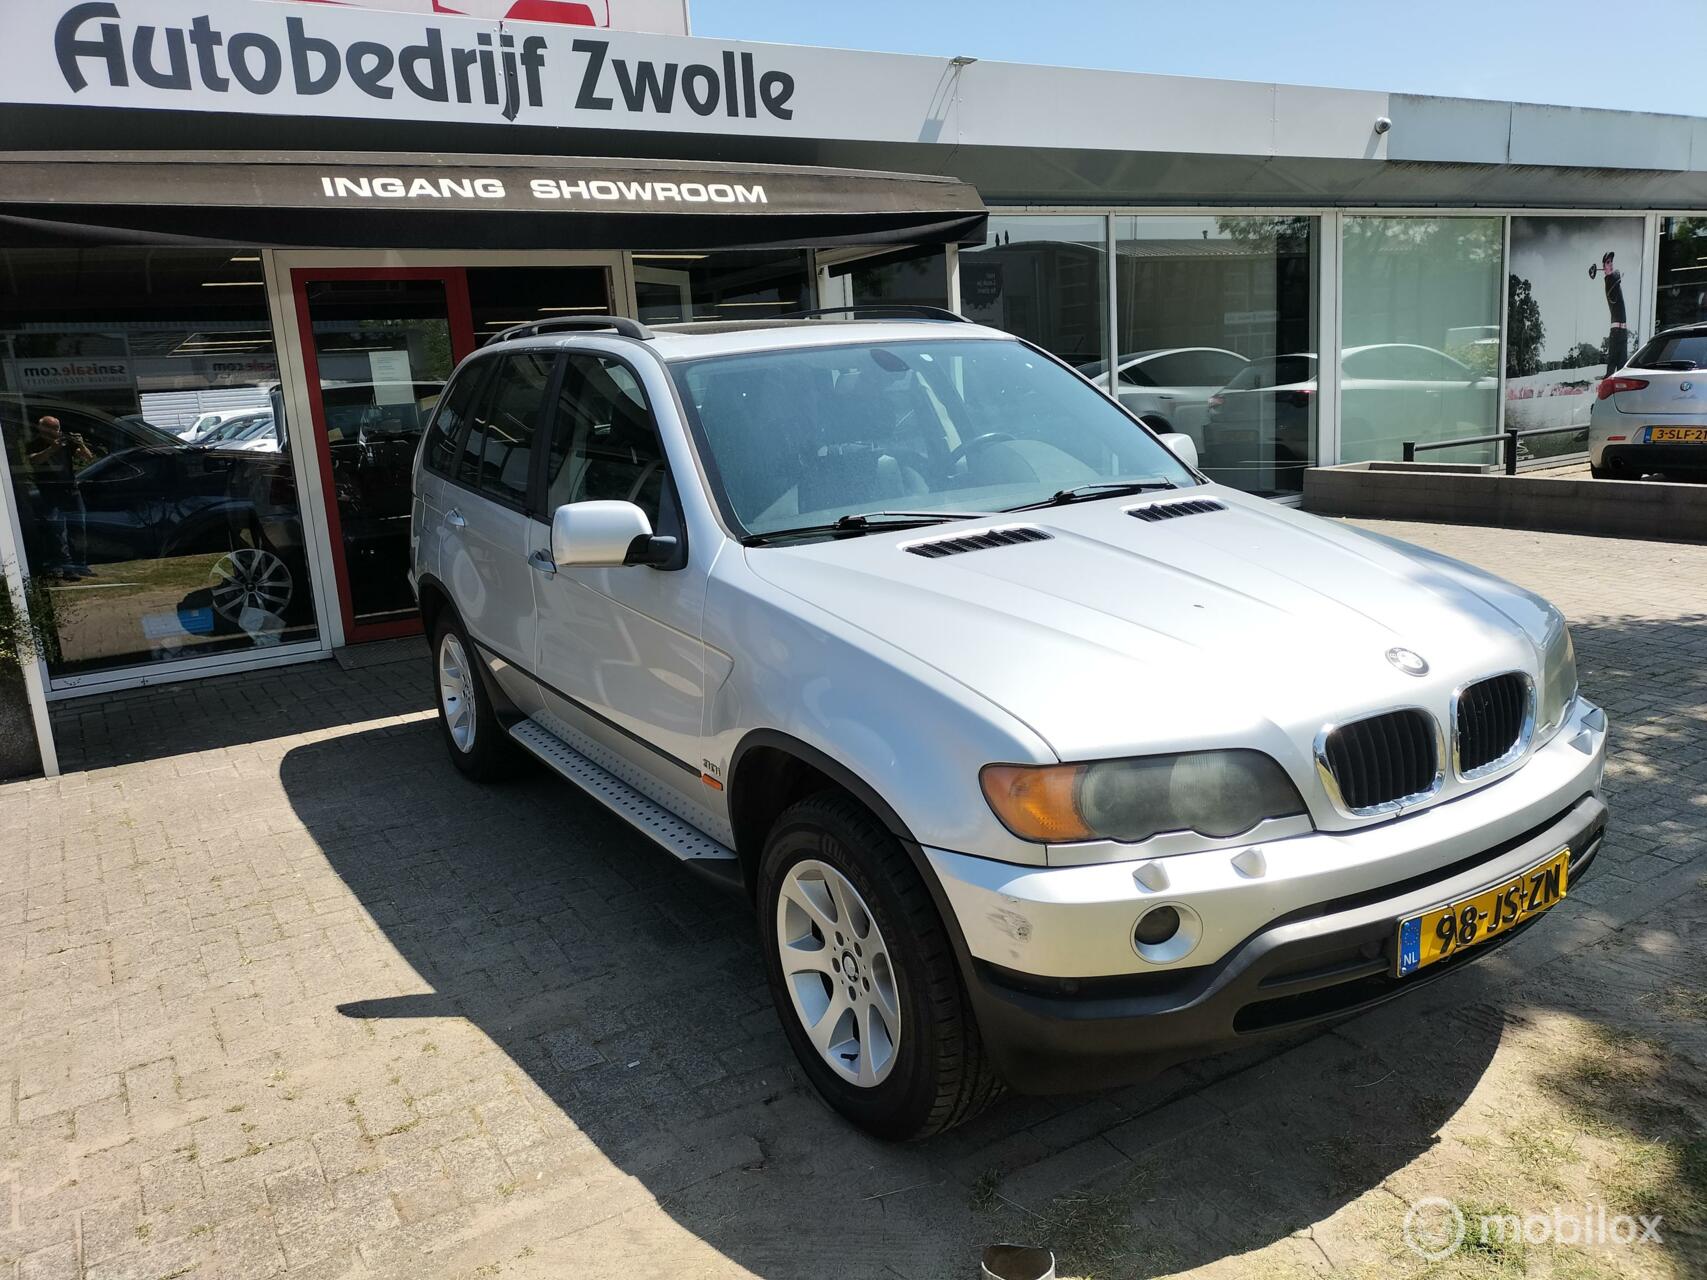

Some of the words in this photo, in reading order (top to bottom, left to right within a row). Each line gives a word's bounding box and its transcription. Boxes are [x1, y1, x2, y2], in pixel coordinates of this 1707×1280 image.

[54, 2, 547, 122] Autobedrijf
[573, 39, 796, 121] Zwolle
[321, 176, 506, 199] INGANG
[529, 179, 769, 204] SHOWROOM
[1436, 863, 1561, 955] 98-JS-ZN
[1403, 951, 1418, 966] NL
